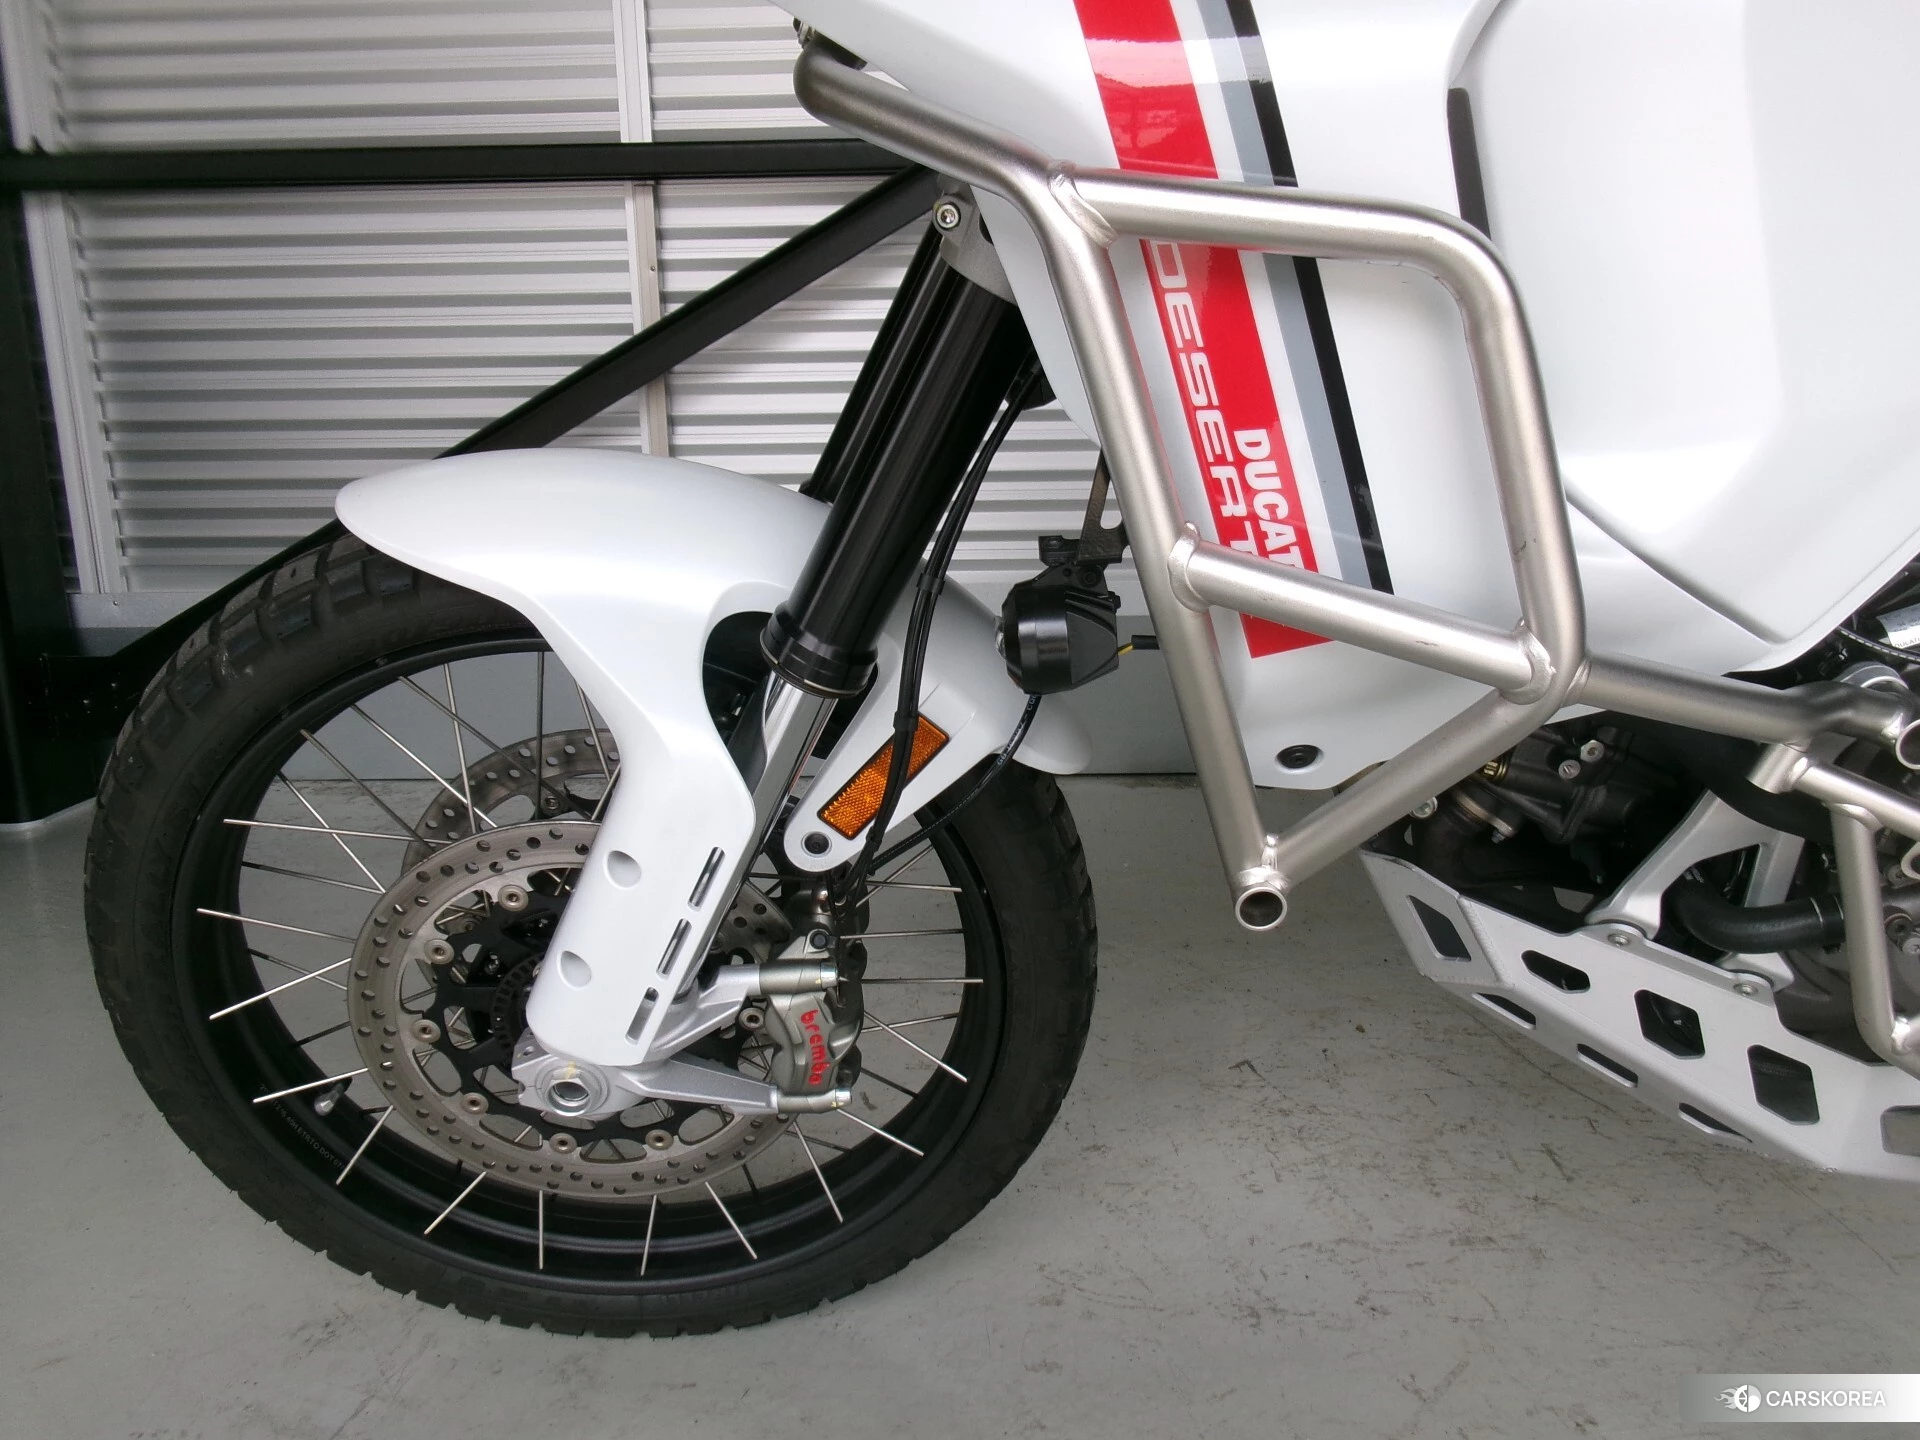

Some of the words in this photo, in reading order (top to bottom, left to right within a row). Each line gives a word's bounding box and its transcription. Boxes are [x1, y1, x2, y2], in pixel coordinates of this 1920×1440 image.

[1149, 240, 1261, 558] DESERT
[1234, 428, 1306, 569] DUCAT
[800, 1009, 830, 1085] brembo
